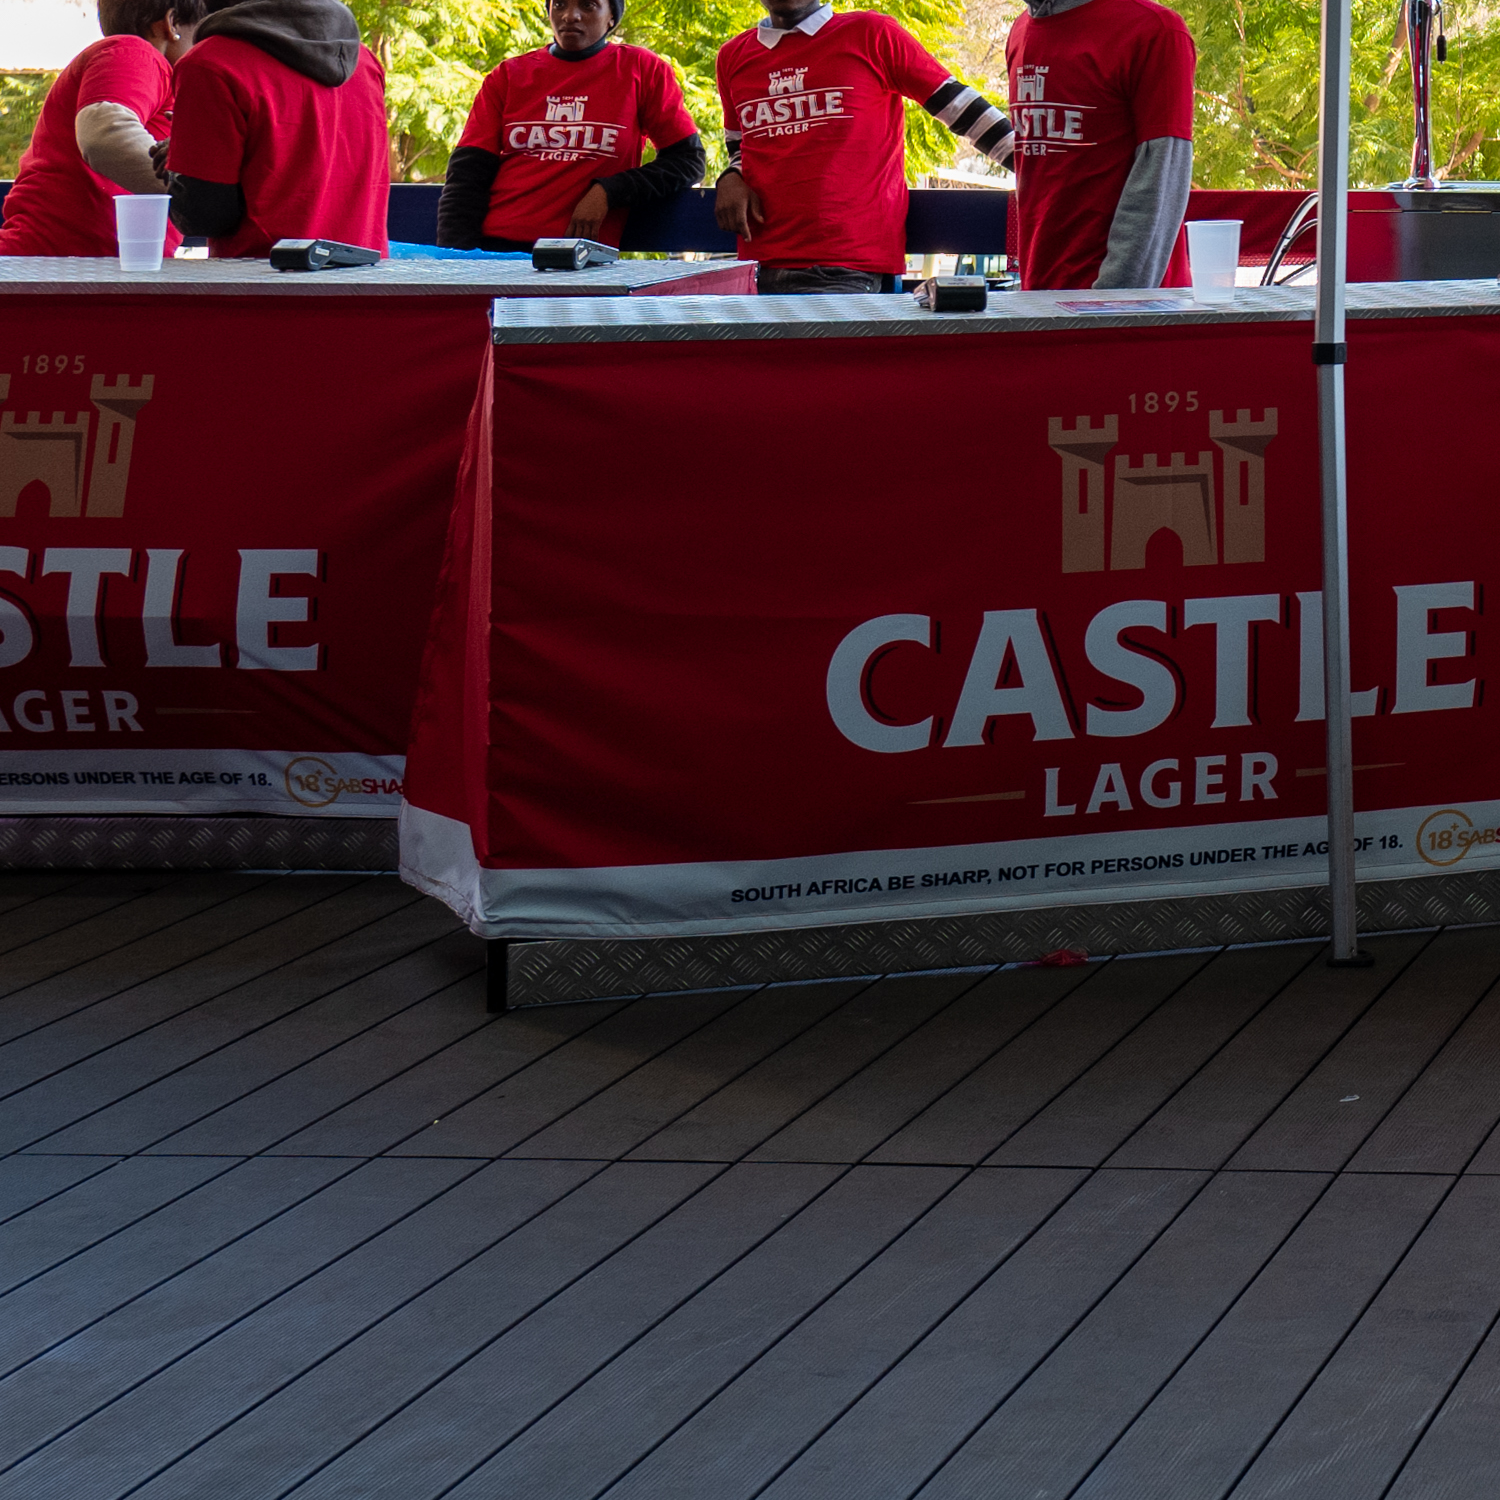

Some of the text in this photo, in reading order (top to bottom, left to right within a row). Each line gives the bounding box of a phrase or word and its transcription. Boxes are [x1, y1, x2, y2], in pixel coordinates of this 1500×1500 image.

[741, 92, 844, 128] CASTLE
[509, 125, 619, 152] CASTLE
[768, 123, 809, 137] LAGER
[540, 151, 579, 161] LAGER
[22, 354, 86, 374] 1895
[1128, 391, 1200, 413] 1895
[826, 580, 1478, 753] CASTLE
[74, 772, 136, 785] UNDER
[139, 772, 175, 785] THE
[178, 772, 217, 785] AGE
[219, 772, 243, 785] OF
[247, 772, 273, 786] 18.
[1044, 751, 1280, 817] LAGER
[731, 883, 802, 903] SOUTH
[806, 878, 883, 897] AFRICA
[887, 875, 915, 891] BE
[920, 868, 992, 888] SHARP,
[997, 864, 1040, 882] NOT
[1044, 860, 1086, 878] FOR
[1090, 852, 1184, 876] PERSONS
[1189, 847, 1257, 866] UNDER
[1262, 842, 1299, 859] THE
[1302, 841, 1329, 856] AG
[1379, 834, 1404, 850] 18.
